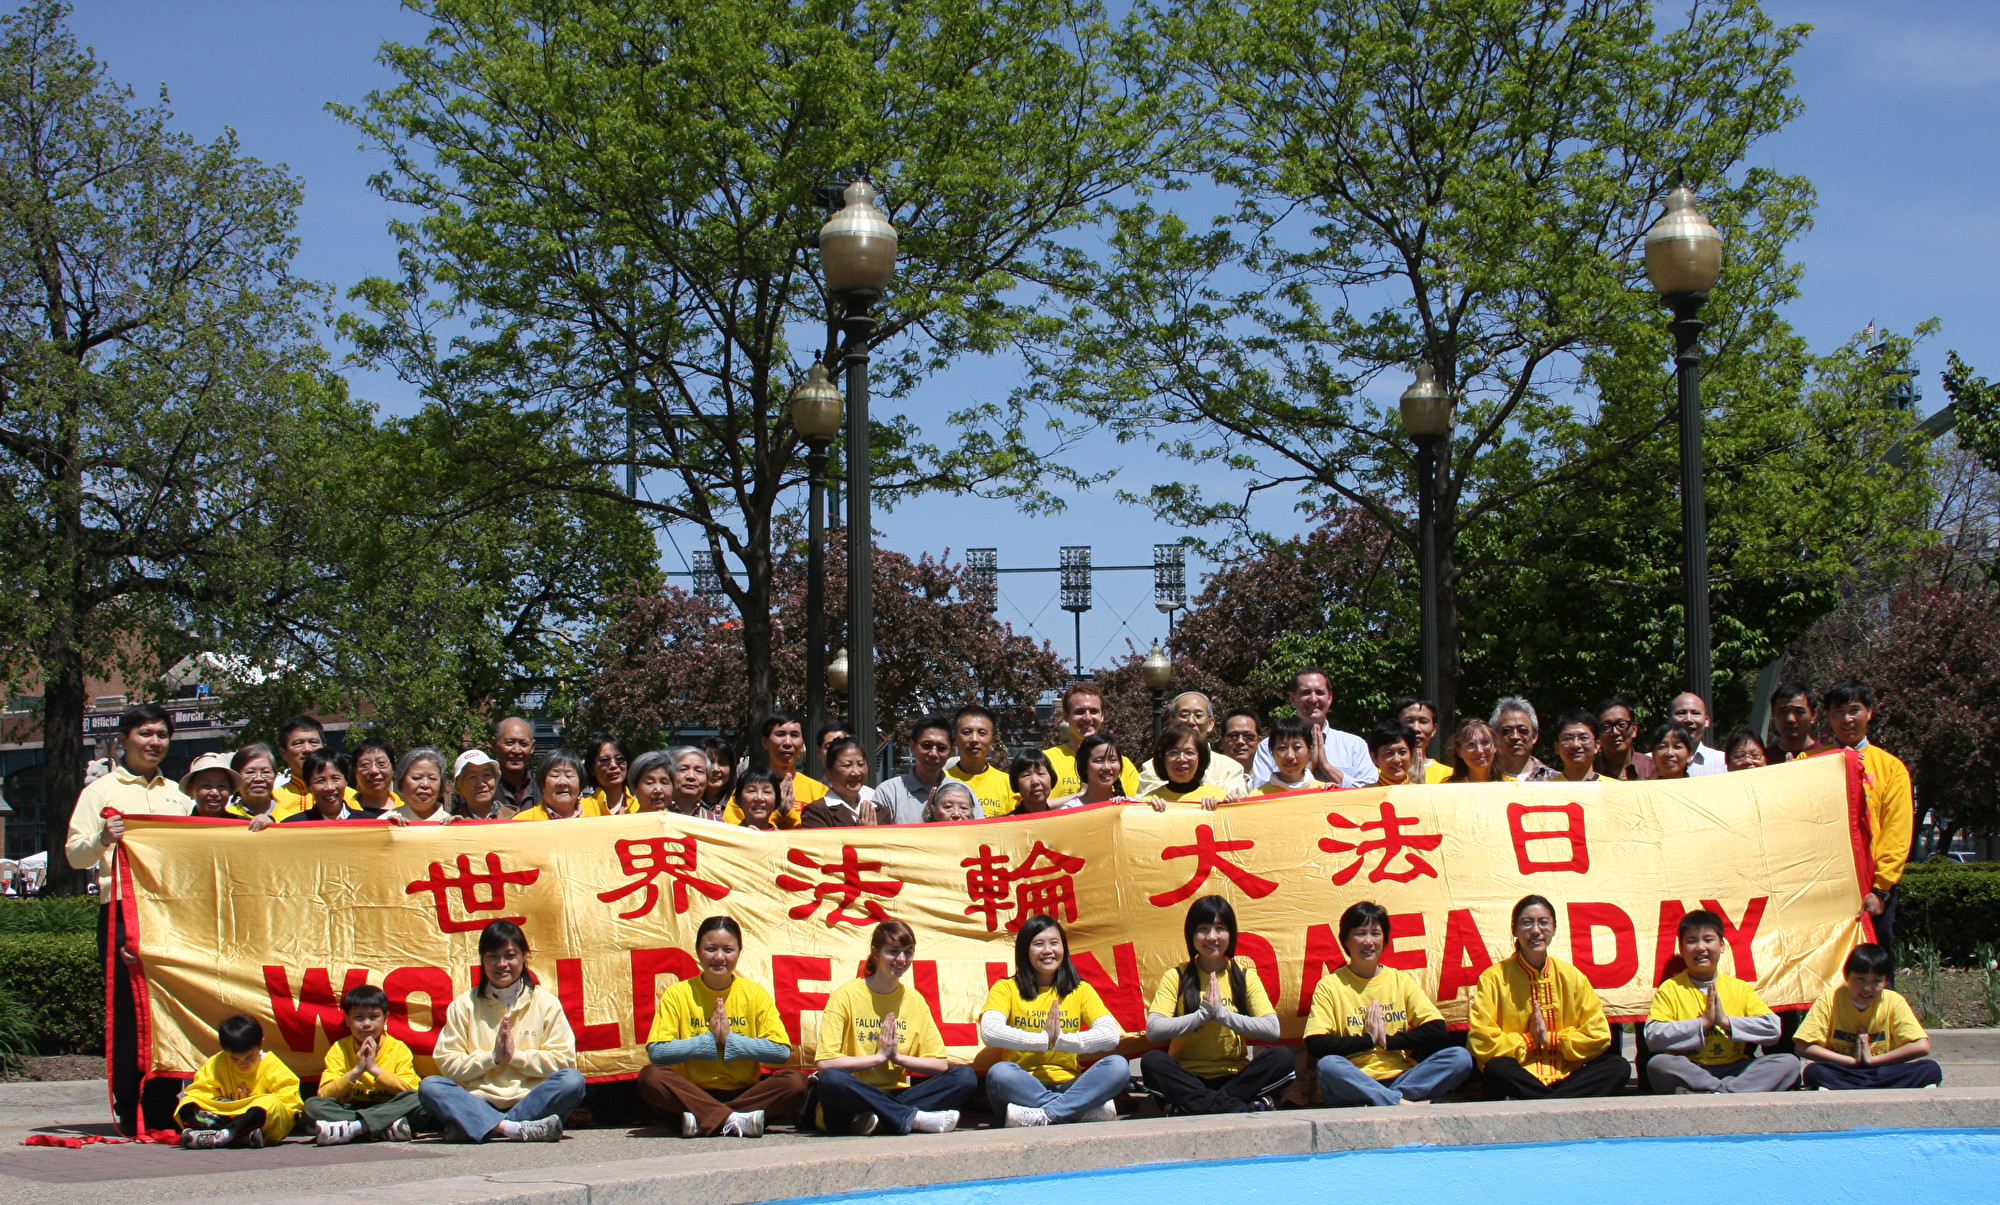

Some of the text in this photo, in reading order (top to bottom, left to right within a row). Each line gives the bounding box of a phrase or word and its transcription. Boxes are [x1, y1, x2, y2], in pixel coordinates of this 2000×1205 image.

[92, 716, 120, 728] Official
[406, 801, 1590, 934] 世界法輪大法日
[262, 947, 703, 1056] WOLD
[1359, 1003, 1394, 1015] SUORT
[691, 1016, 746, 1027] FALU ONG
[896, 1021, 907, 1030] NG
[1059, 1017, 1079, 1028] ONG
